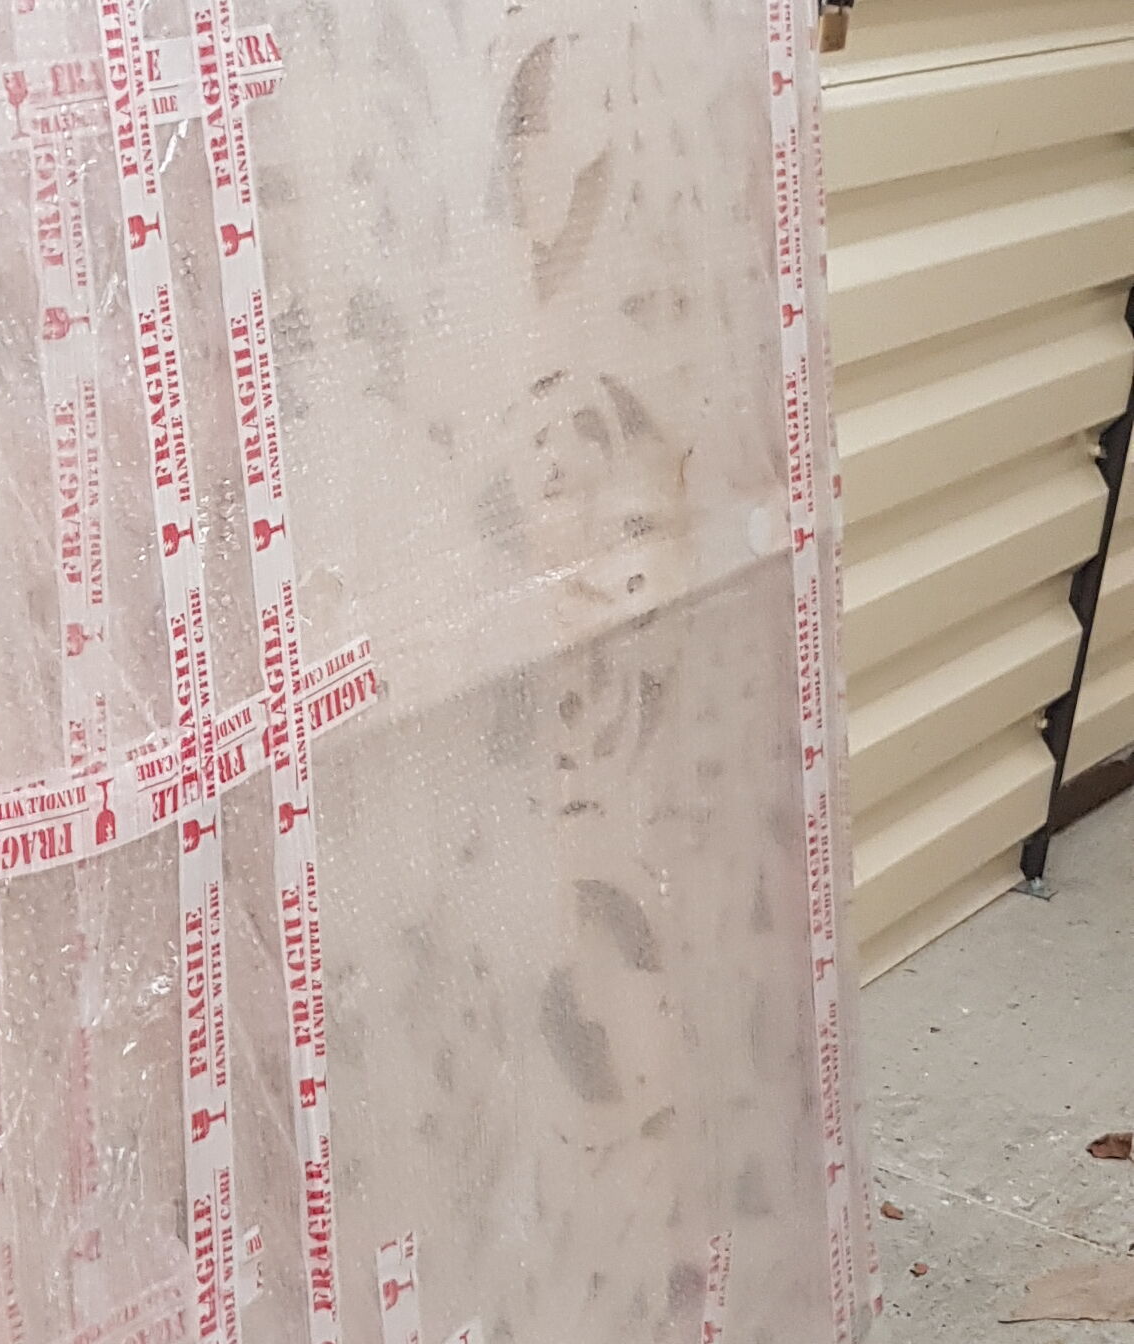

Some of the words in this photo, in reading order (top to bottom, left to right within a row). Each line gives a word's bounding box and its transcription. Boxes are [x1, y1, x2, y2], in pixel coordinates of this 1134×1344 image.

[194, 9, 232, 188] FRAGILE
[138, 105, 156, 194] HANDLE
[233, 119, 250, 204] HANDLE
[775, 142, 790, 274] FRAGILE
[156, 284, 172, 342] CARE
[252, 289, 266, 344] CARE
[139, 309, 173, 489] FRAGILE
[164, 350, 181, 408] WITH
[230, 313, 264, 486] FRAGILE
[259, 353, 274, 409] WITH
[170, 414, 191, 501] HANDLE
[265, 415, 282, 499] HANDLE
[786, 372, 802, 502] FRAGILE
[189, 586, 203, 644] CARE
[282, 579, 295, 634] CARE
[171, 613, 203, 786] FRAGILE
[196, 651, 210, 707] WITH
[262, 605, 290, 772] FRAGILE
[288, 640, 302, 695] WITH
[797, 595, 812, 721] FRAGILE
[293, 700, 308, 781] HANDLE
[26, 785, 86, 817] HANDLE
[186, 907, 207, 1078] FRAGILE
[210, 943, 222, 999] WITH
[282, 885, 312, 1048] FRAGILE
[214, 1004, 226, 1087] HANDLE
[219, 1167, 231, 1220] CARE
[304, 1160, 333, 1313] FRAGILE
